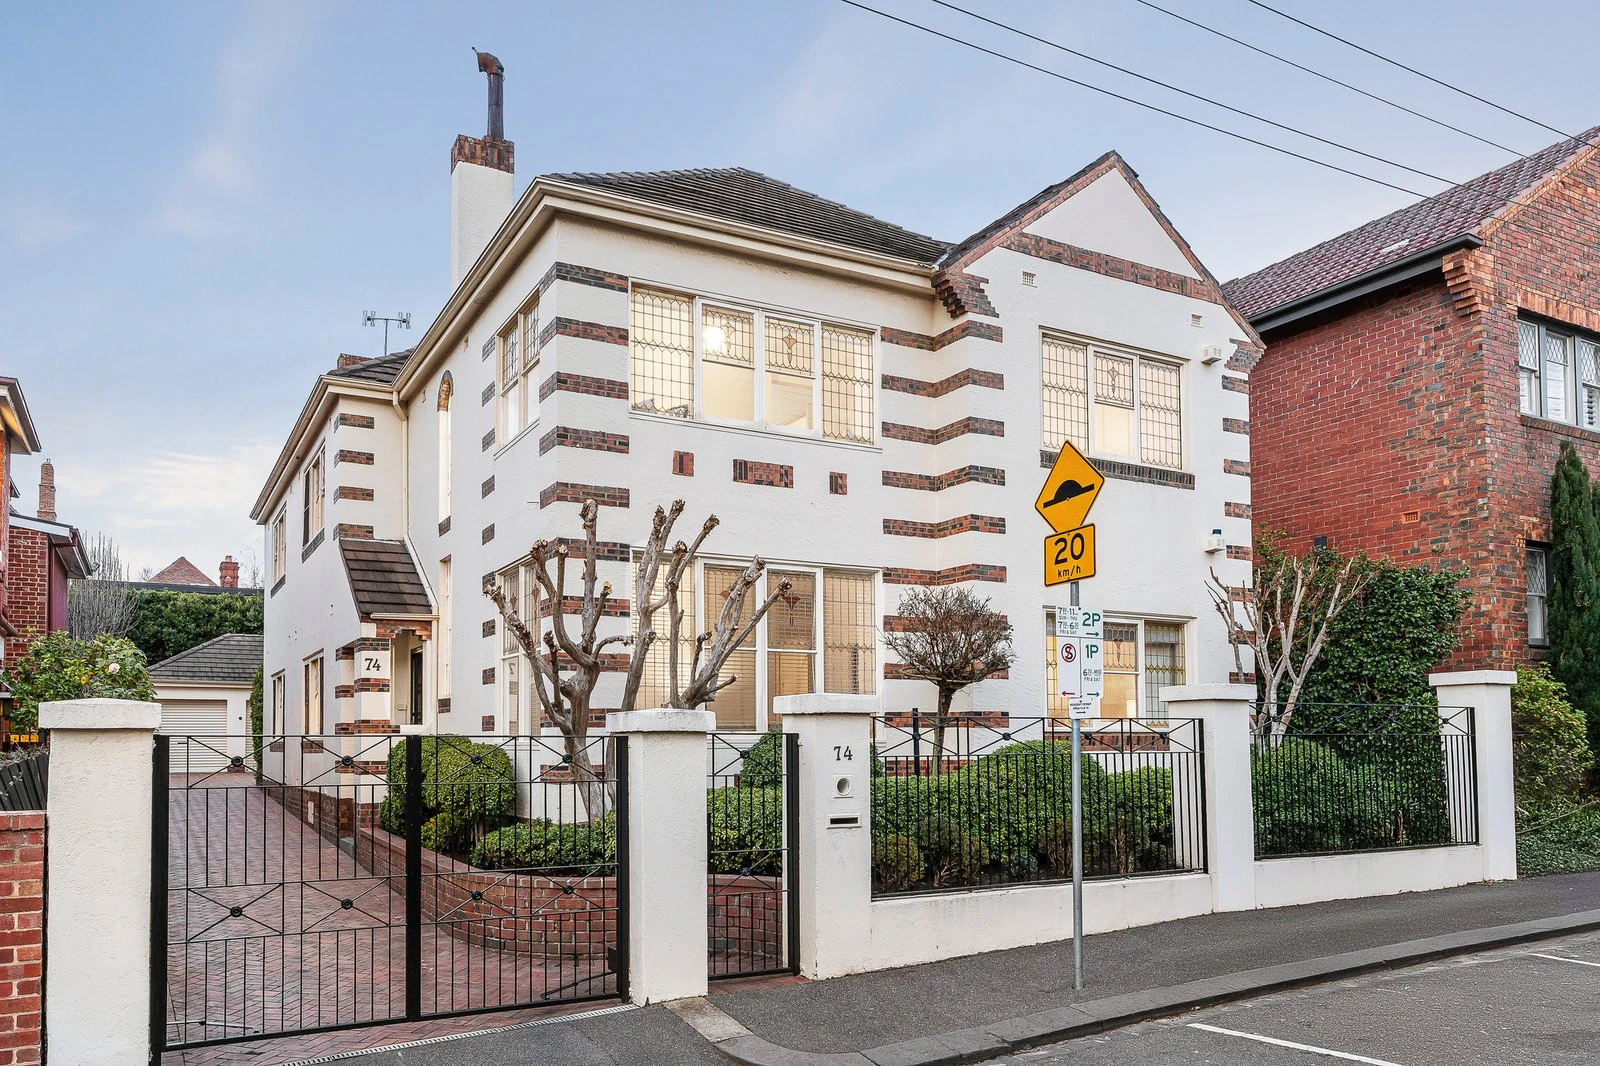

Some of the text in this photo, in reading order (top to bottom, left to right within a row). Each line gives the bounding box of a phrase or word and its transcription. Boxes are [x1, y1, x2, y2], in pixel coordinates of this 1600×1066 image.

[1054, 532, 1085, 565] 20
[1057, 565, 1081, 578] km/h
[1082, 611, 1101, 627] 2P
[1085, 644, 1099, 659] 1P
[364, 657, 382, 671] 74
[833, 745, 853, 761] 74
